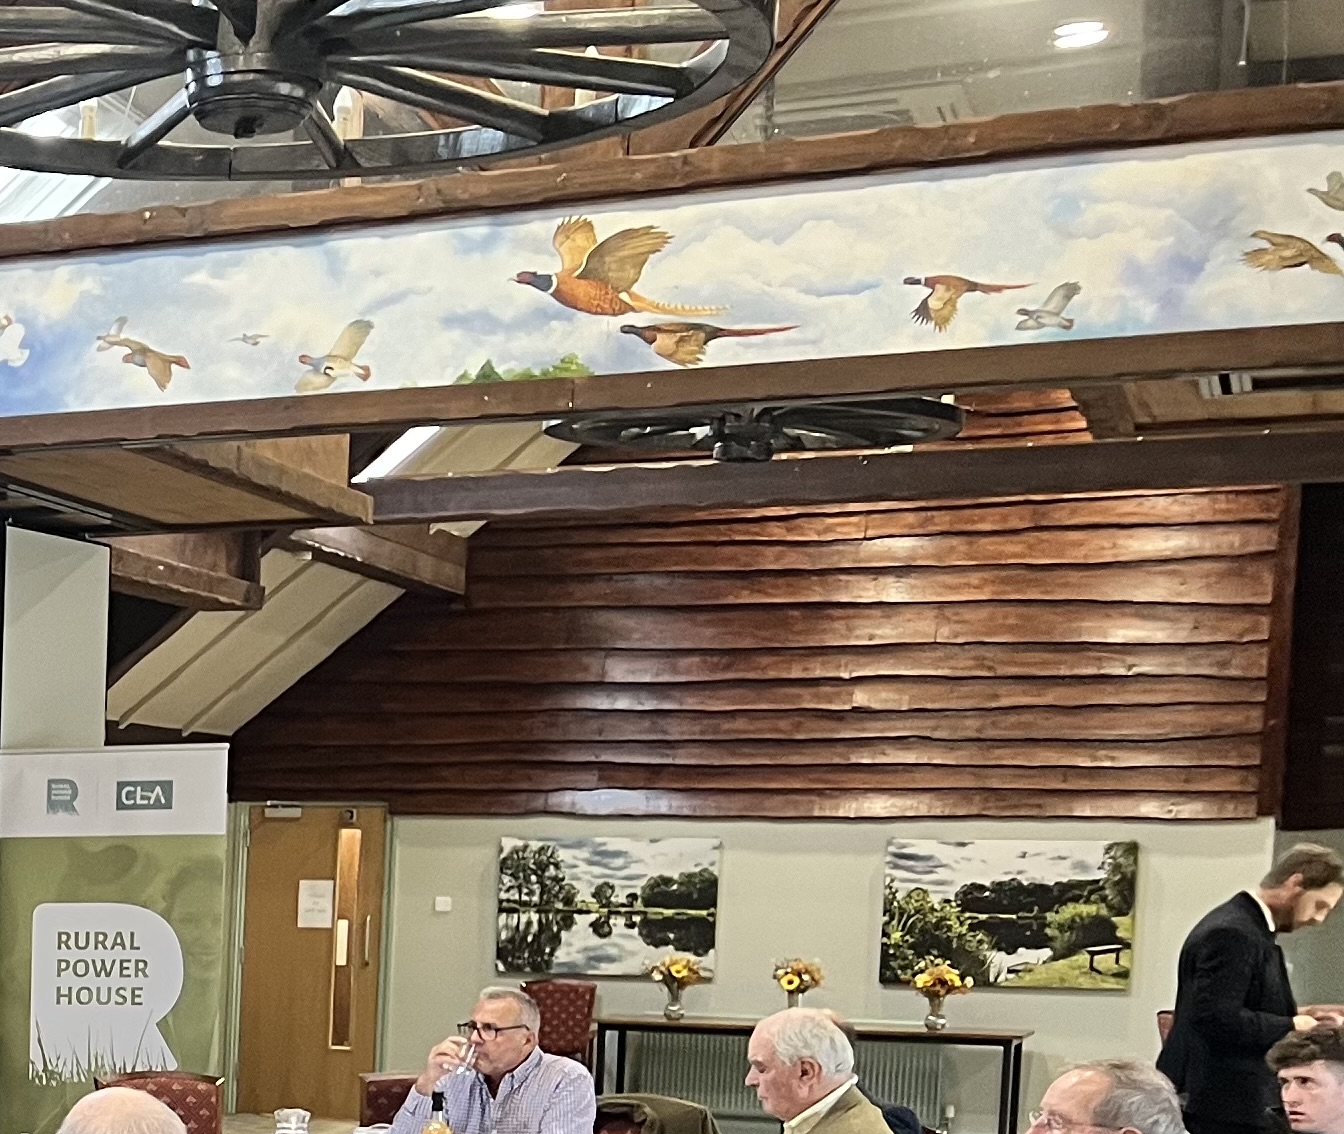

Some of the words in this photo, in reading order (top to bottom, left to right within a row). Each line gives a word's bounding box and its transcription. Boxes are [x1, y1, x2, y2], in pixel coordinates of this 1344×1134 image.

[121, 785, 166, 805] CLA
[56, 931, 141, 951] RURAL
[56, 958, 150, 979] POWER
[55, 986, 144, 1006] HOUSE
